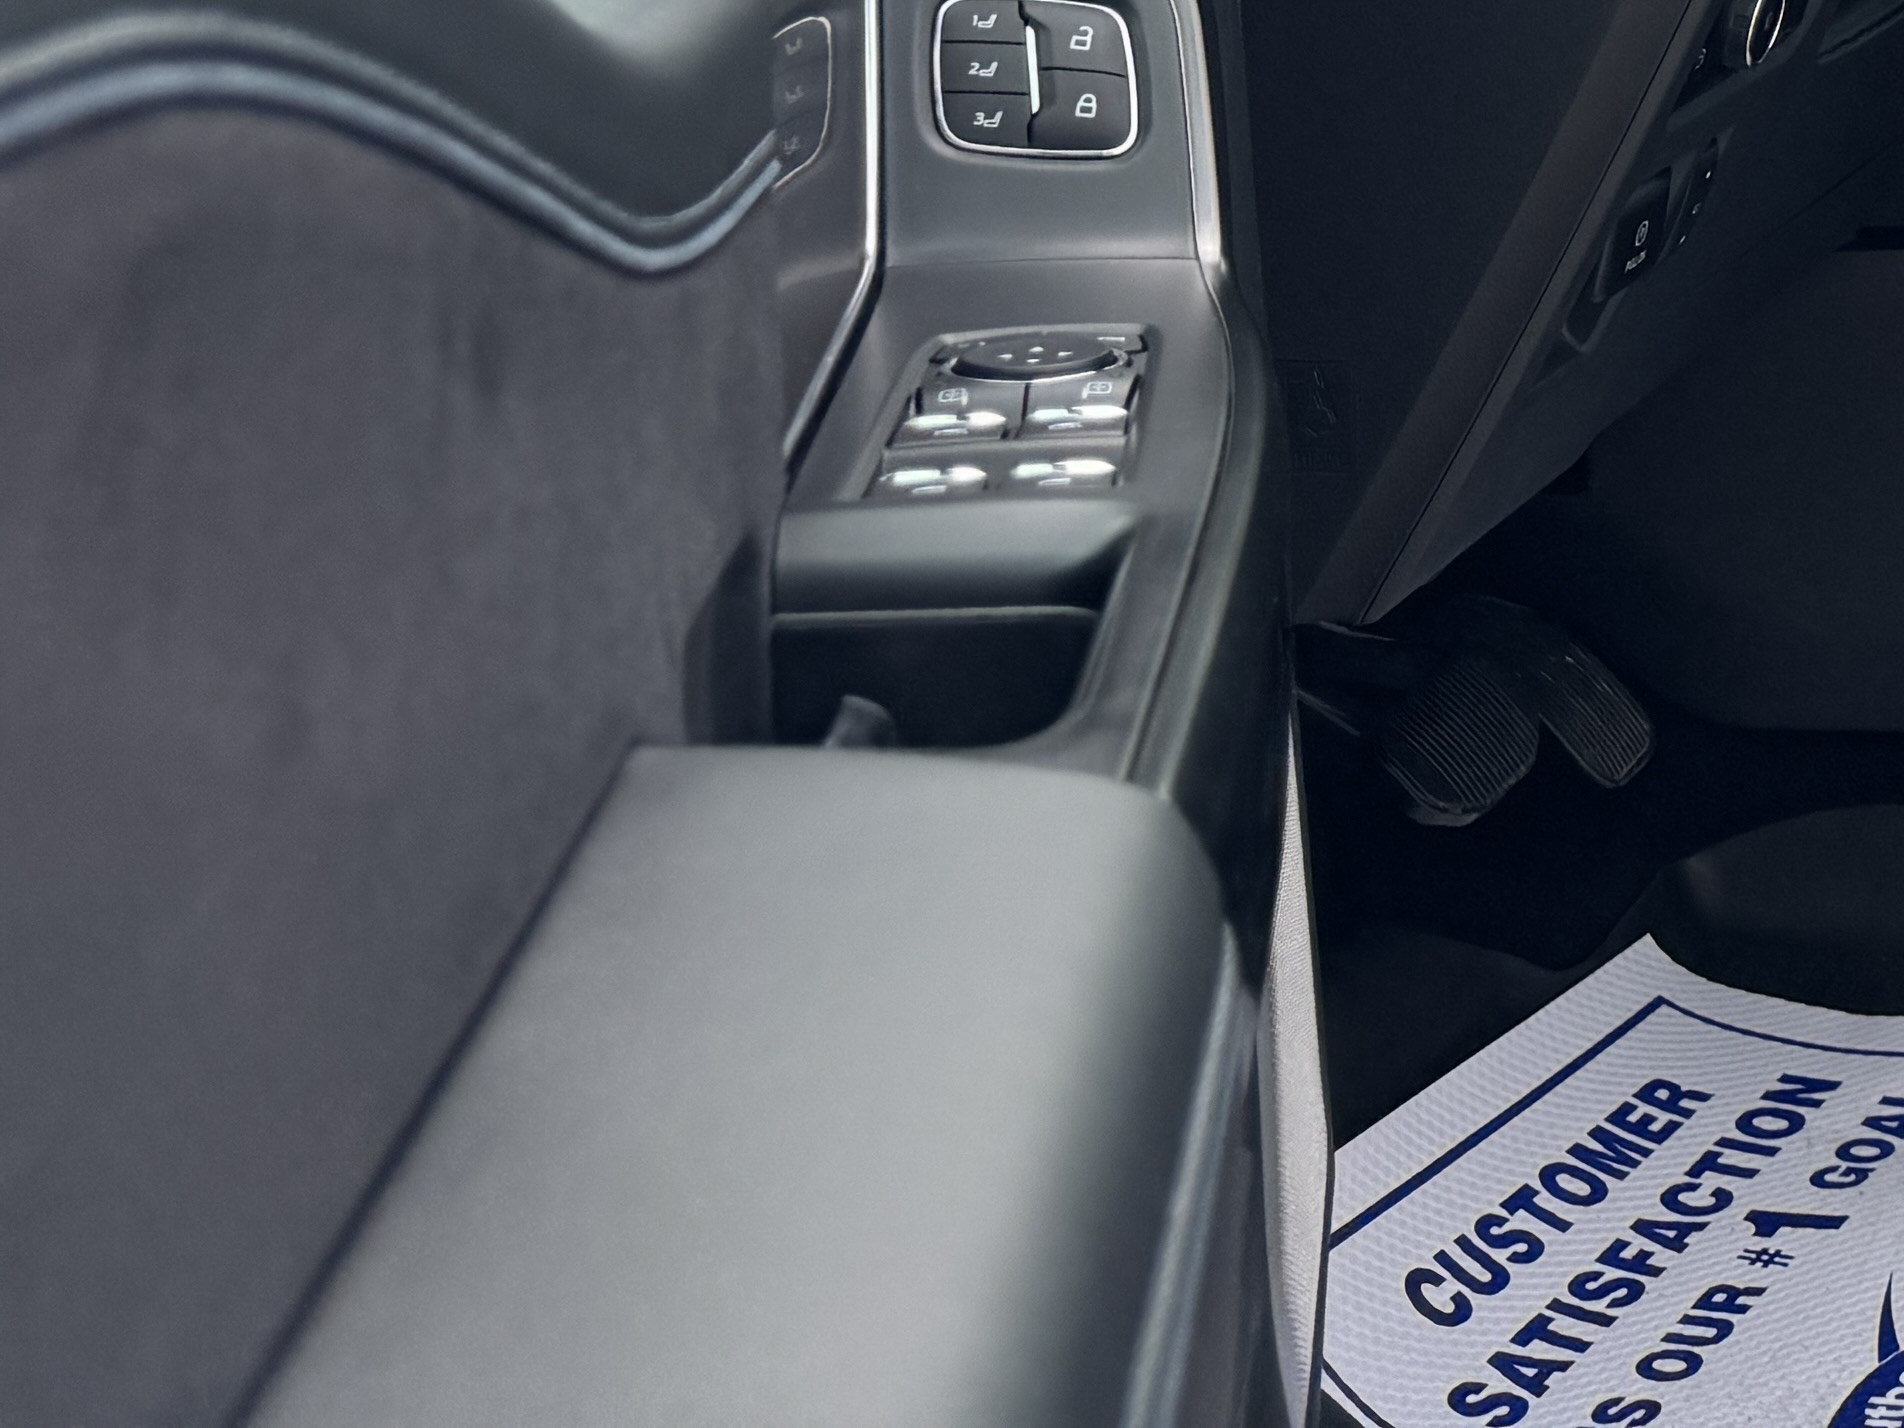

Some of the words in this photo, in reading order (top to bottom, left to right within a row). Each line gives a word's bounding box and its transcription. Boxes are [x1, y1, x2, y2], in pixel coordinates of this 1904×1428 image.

[972, 14, 978, 26] 1
[968, 62, 980, 75] 2
[973, 112, 985, 125] 3
[1404, 1077, 1715, 1327] CUSTOMER
[1446, 1073, 1843, 1428] SATISFACTION
[1635, 1282, 1768, 1382] OUR
